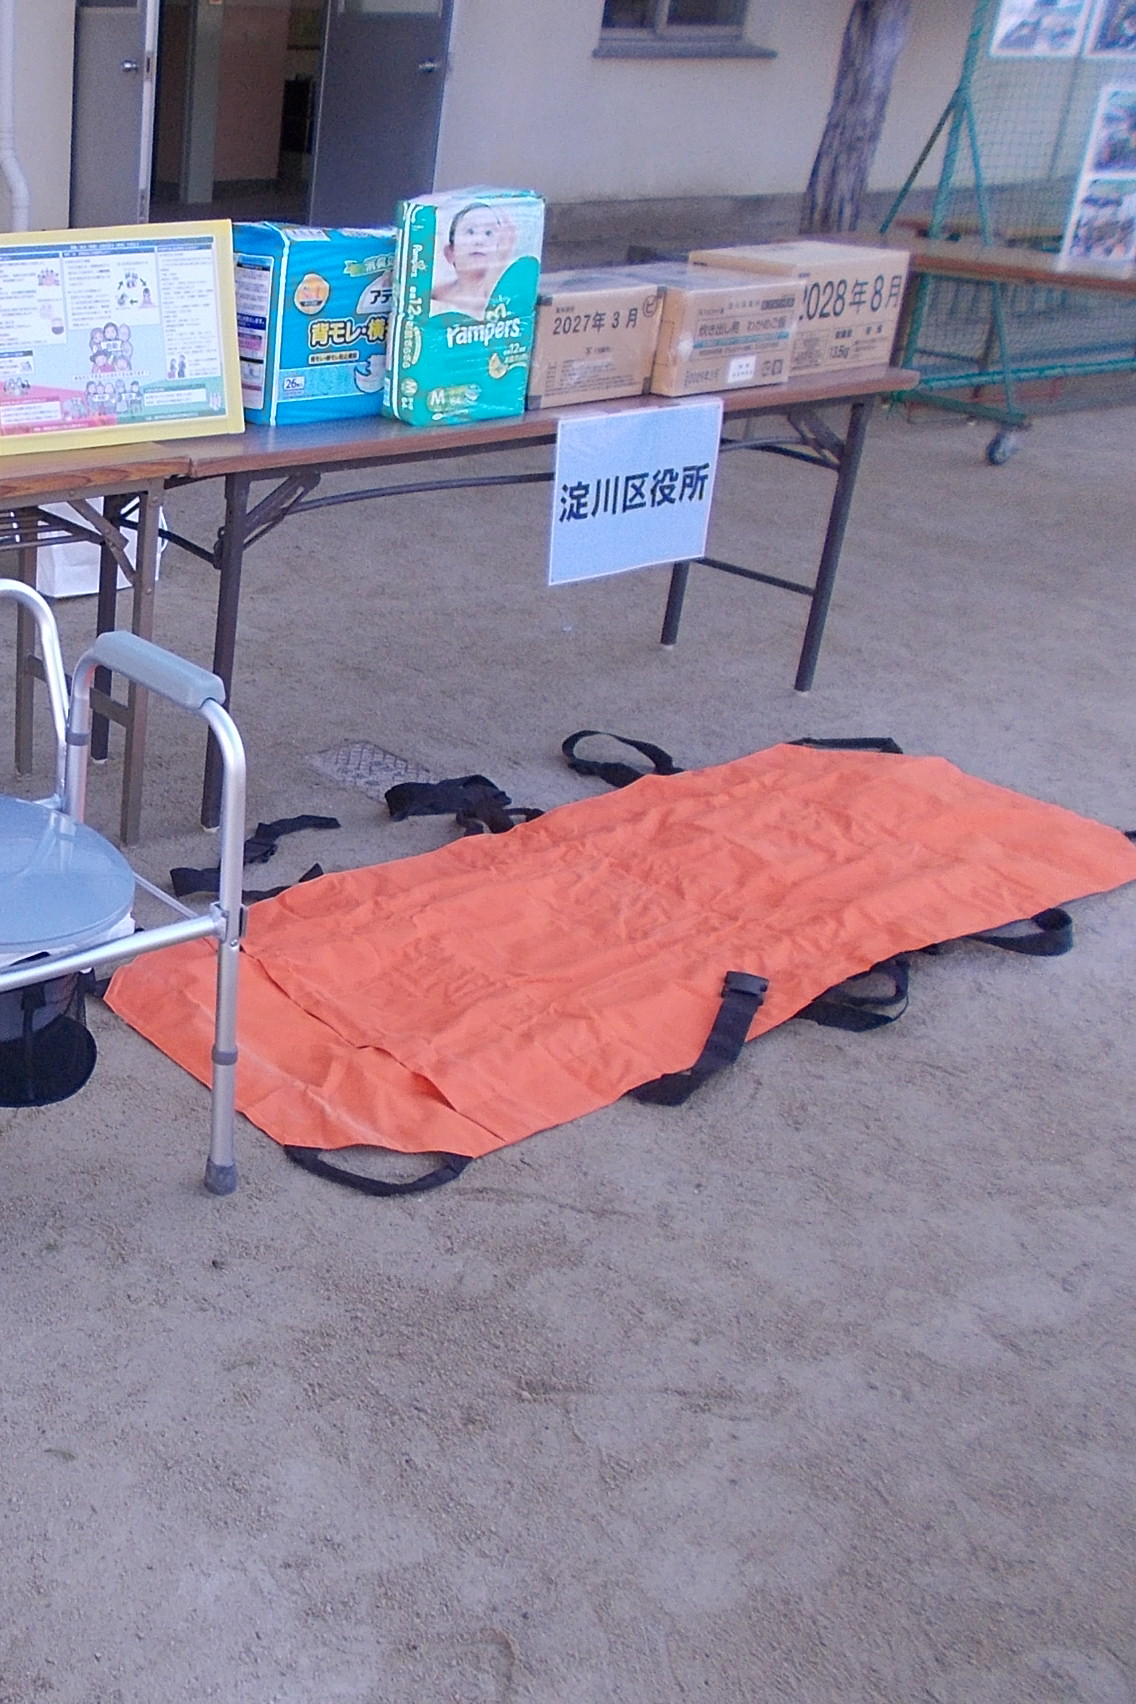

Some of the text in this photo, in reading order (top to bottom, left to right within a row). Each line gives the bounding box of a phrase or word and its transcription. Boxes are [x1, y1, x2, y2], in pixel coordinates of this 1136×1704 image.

[310, 317, 387, 347] 背モレ・横
[430, 388, 446, 406] M
[559, 463, 710, 522] 淀川区役所
